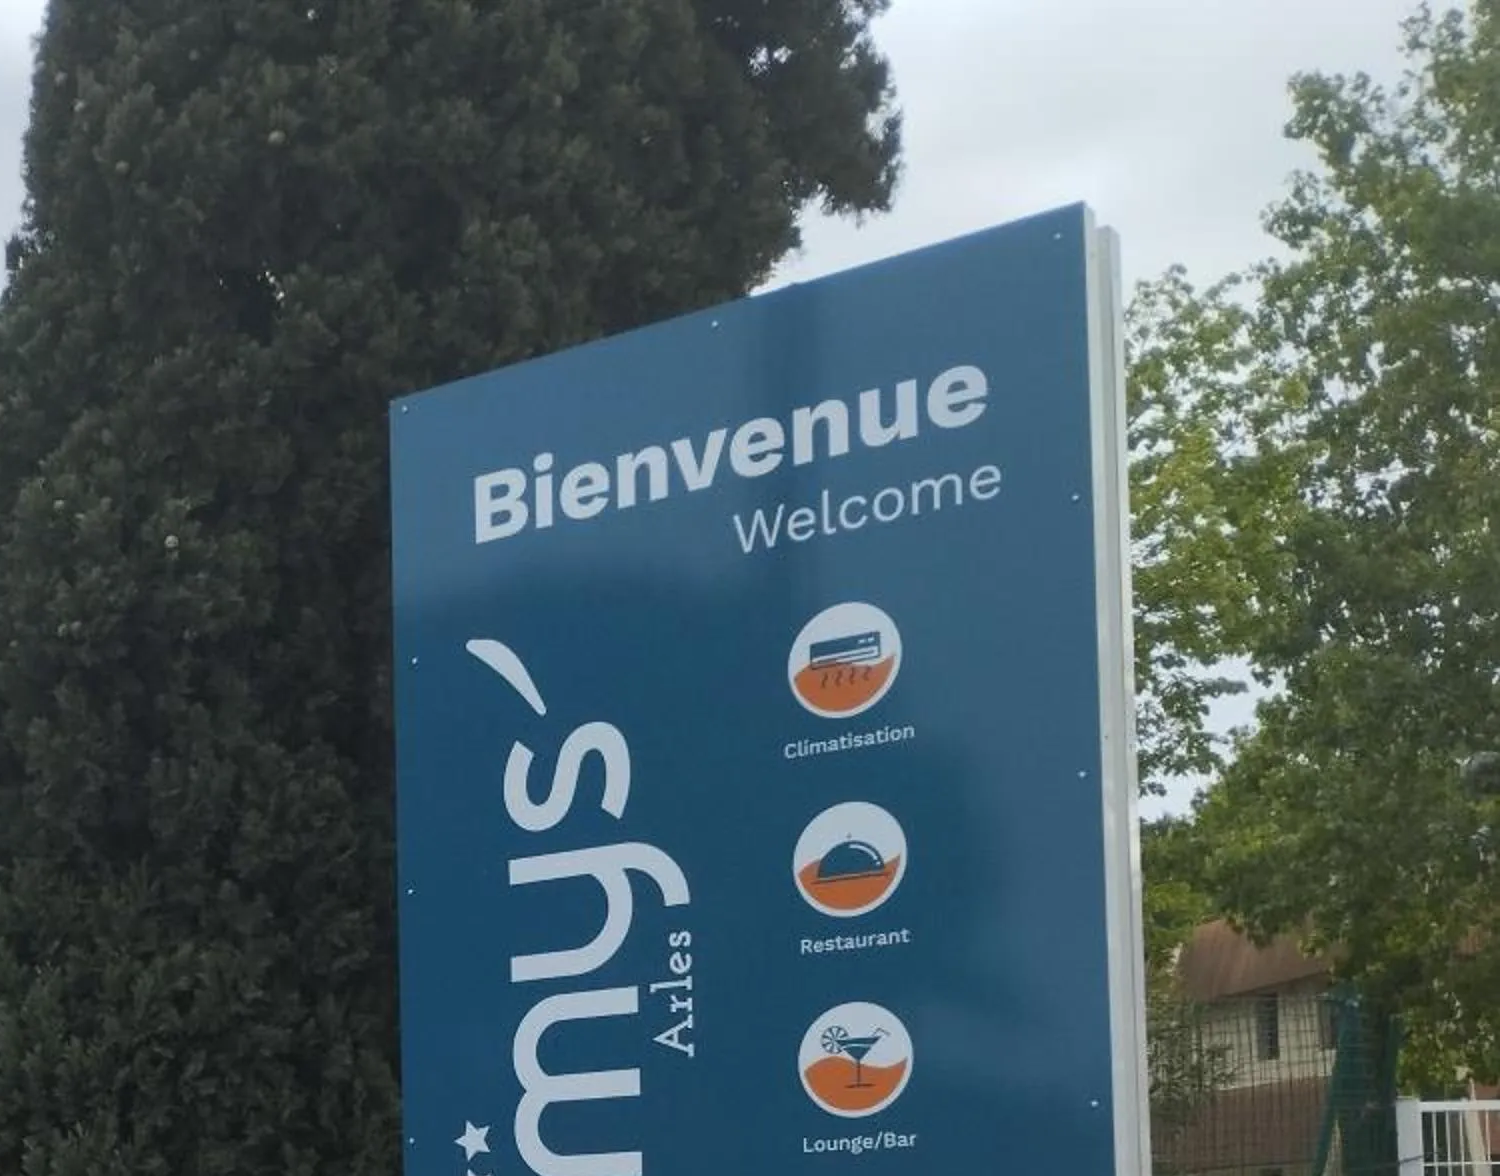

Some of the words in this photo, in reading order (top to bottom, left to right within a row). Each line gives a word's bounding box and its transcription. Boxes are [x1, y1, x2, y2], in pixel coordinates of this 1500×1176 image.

[473, 364, 989, 546] Bienvenue
[733, 464, 1003, 553] Welcome
[783, 724, 916, 760] Climatisation
[800, 928, 911, 955] Restaurant
[649, 930, 696, 1058] Arles
[802, 1131, 917, 1155] Lounge/Bar
